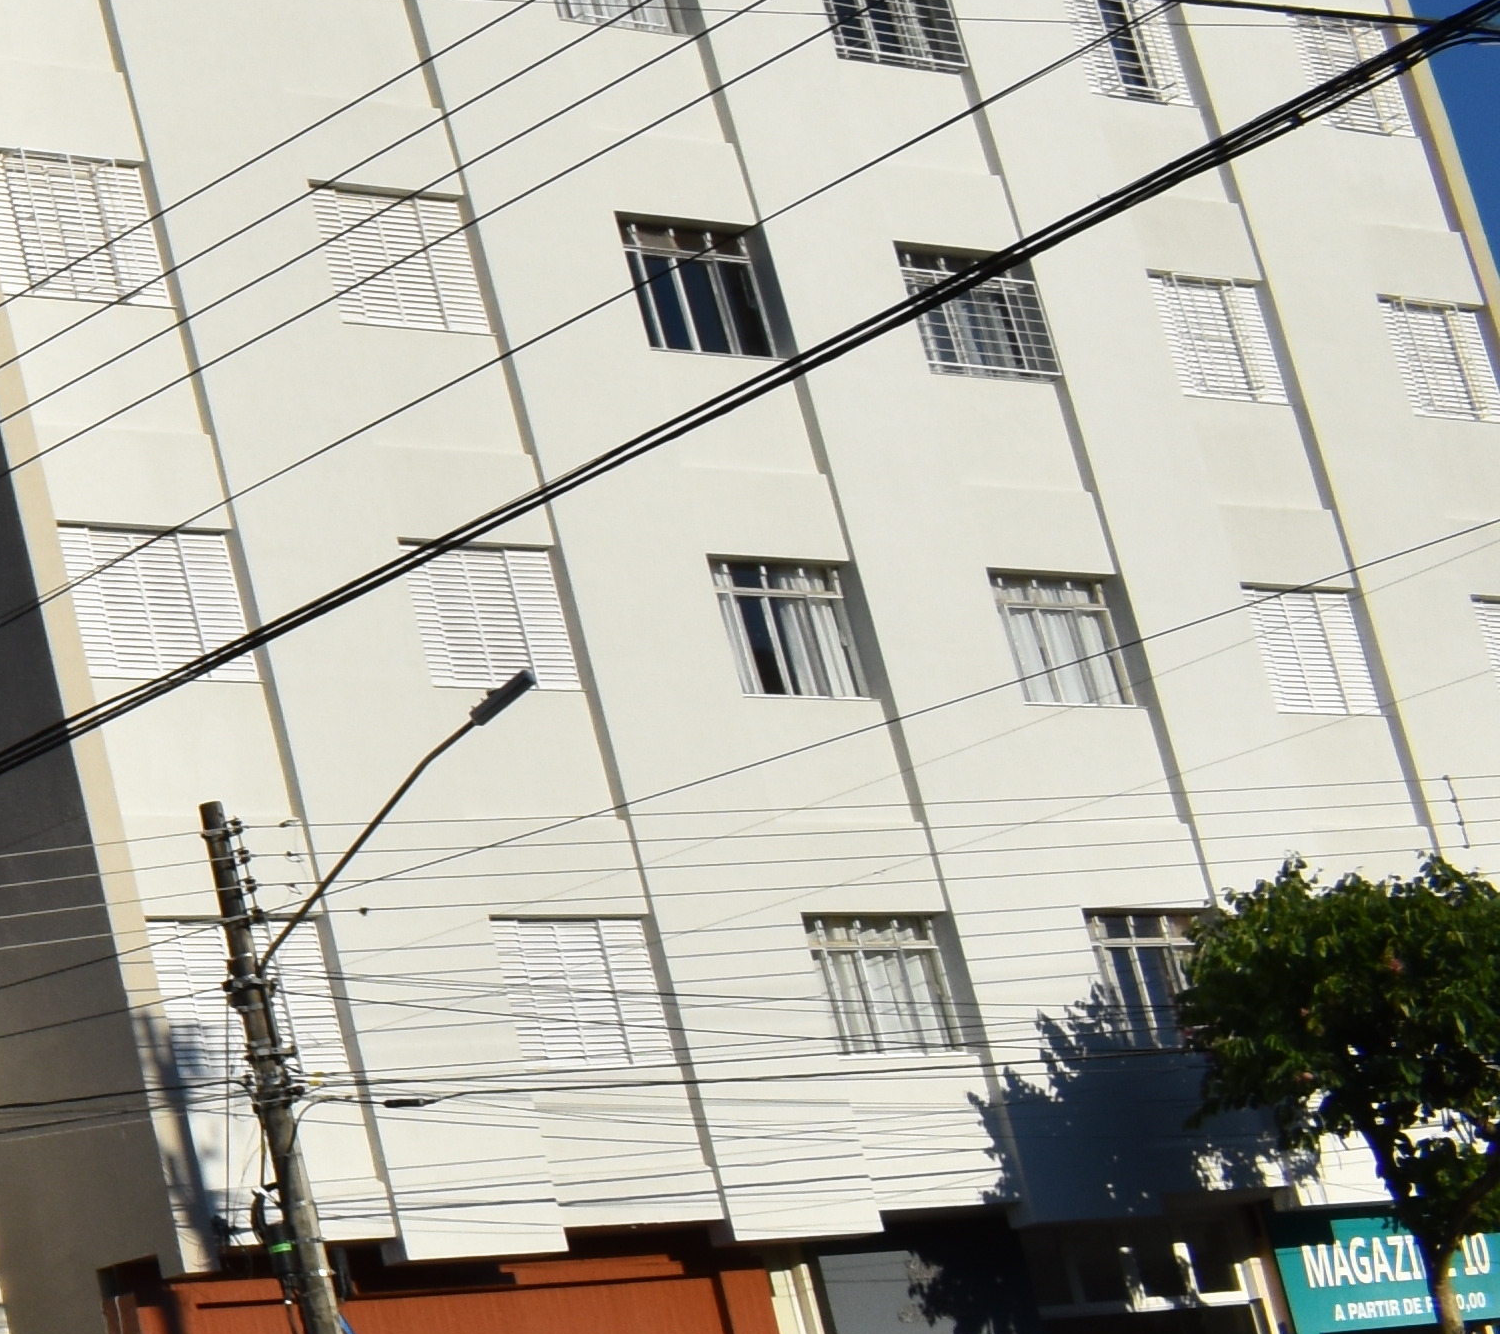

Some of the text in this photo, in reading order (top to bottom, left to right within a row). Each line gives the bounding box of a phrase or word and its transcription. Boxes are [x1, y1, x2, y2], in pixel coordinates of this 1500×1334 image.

[1461, 1232, 1491, 1277] 10
[1334, 1303, 1347, 1322] A
[1348, 1298, 1400, 1321] PARTIR
[1402, 1296, 1424, 1316] DE
